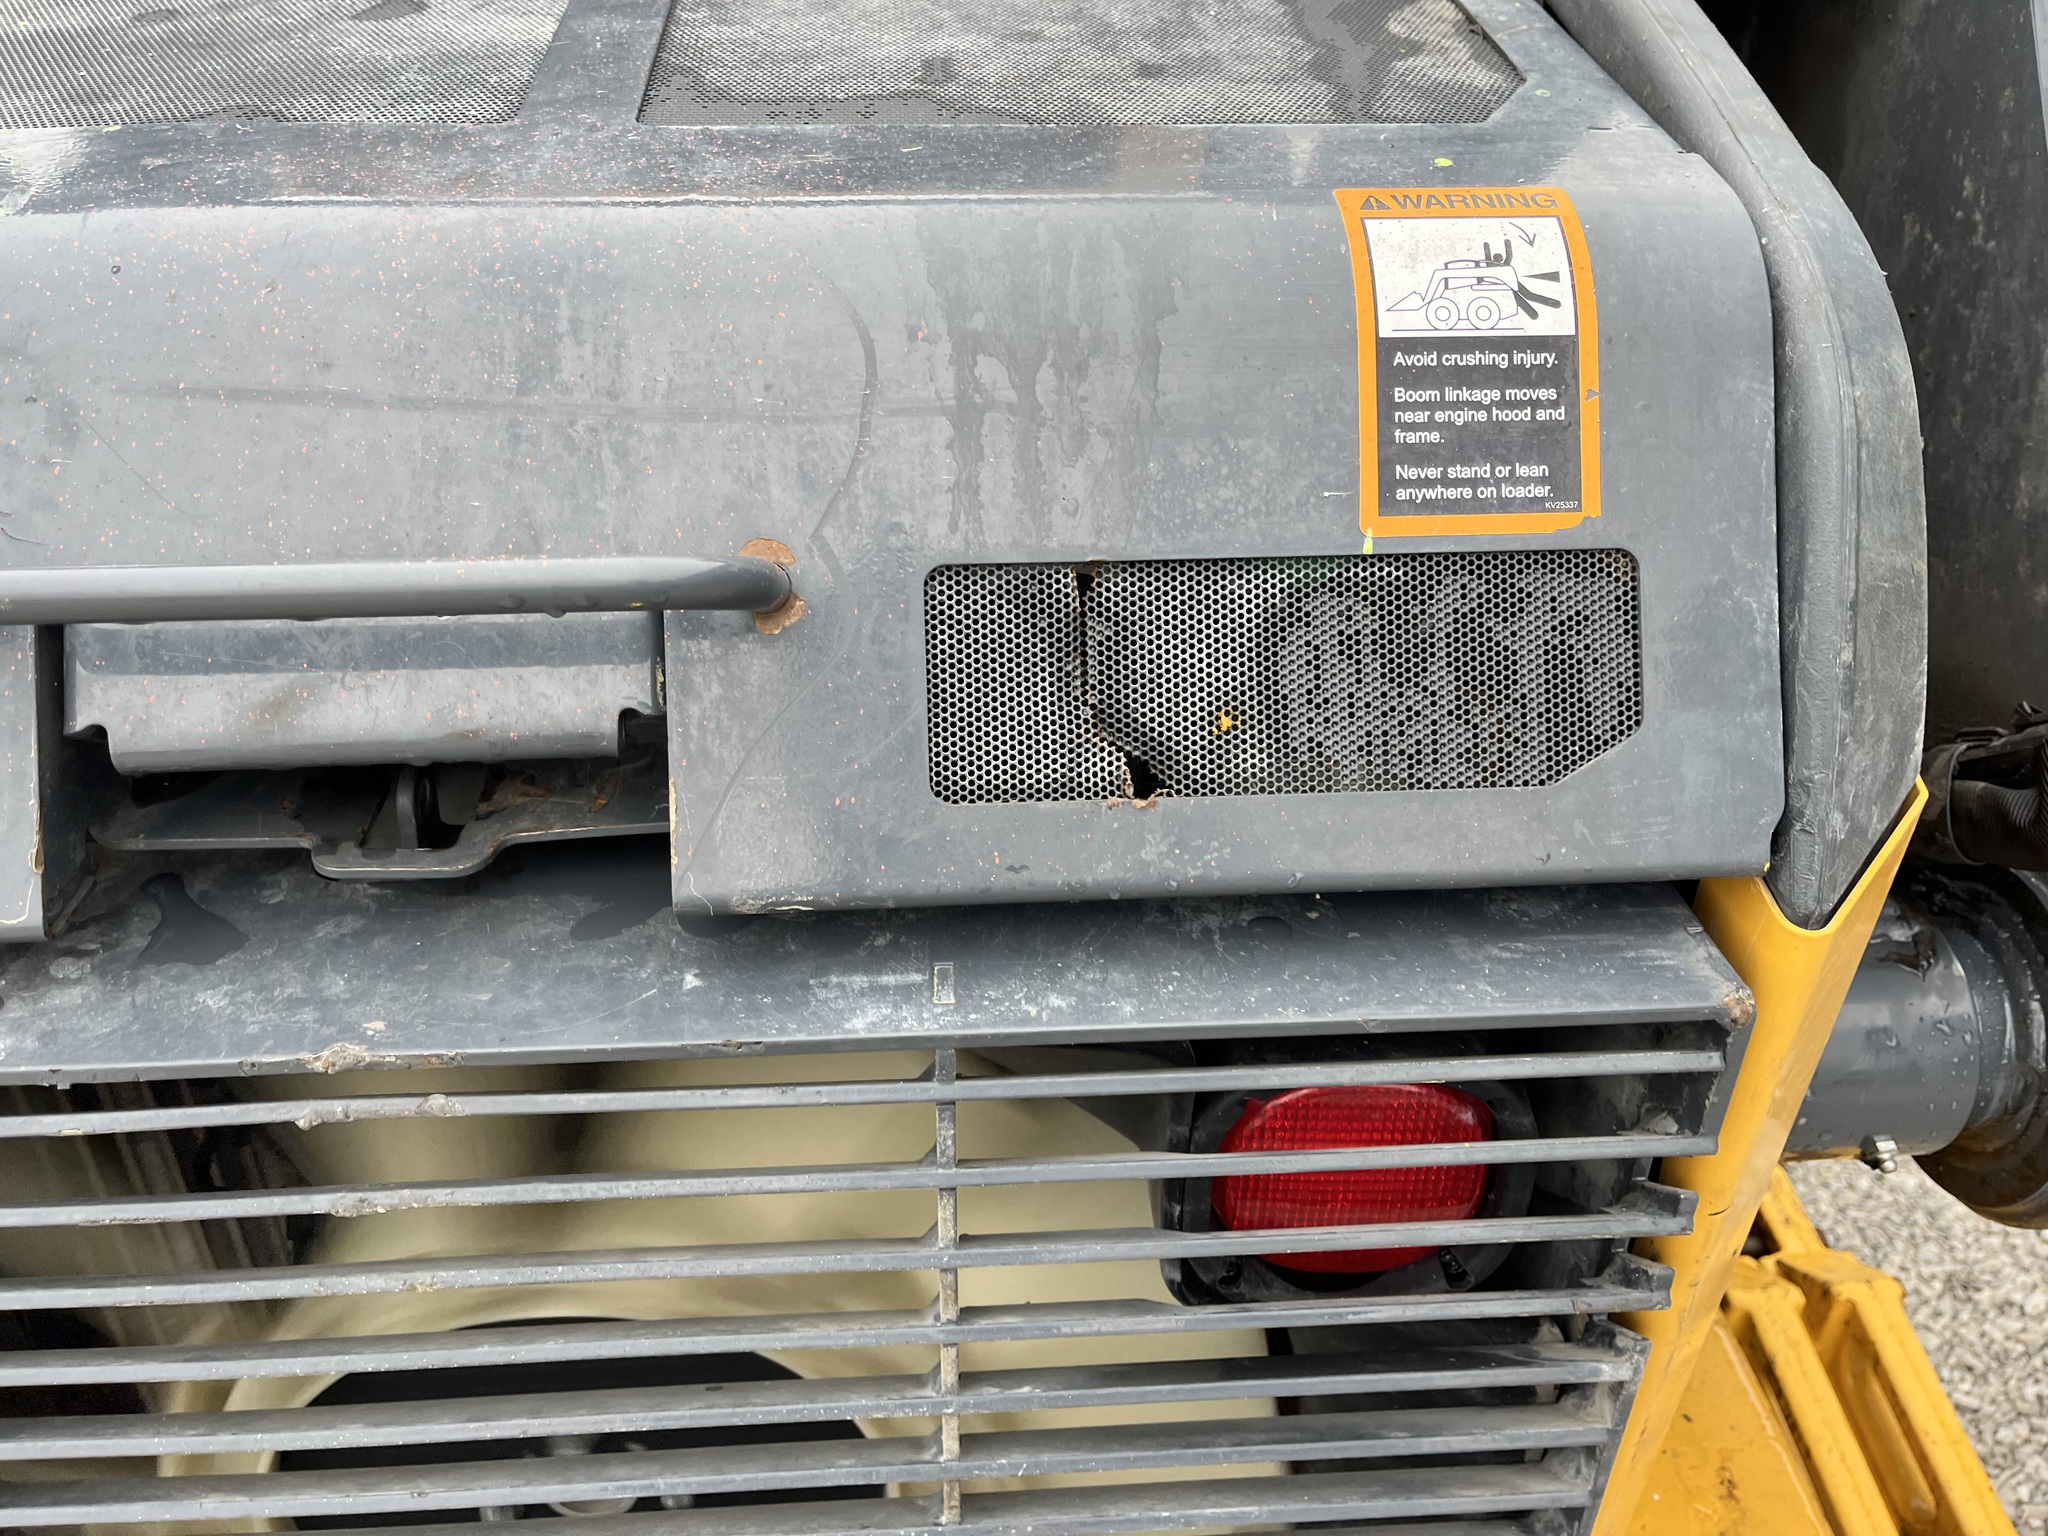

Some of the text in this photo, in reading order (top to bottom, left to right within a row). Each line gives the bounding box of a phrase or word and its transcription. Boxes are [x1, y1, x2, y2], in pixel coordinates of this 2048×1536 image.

[1390, 193, 1559, 210] WARNING
[1393, 350, 1559, 369] Avoid crushing injury.
[1394, 386, 1558, 405] Boom linkage moves
[1394, 406, 1566, 426] near engine hood and
[1394, 429, 1445, 444] frame.
[1395, 463, 1549, 480] Never stand or lean
[1395, 483, 1554, 503] anywhere on loader.
[1545, 501, 1578, 509] KV25337
